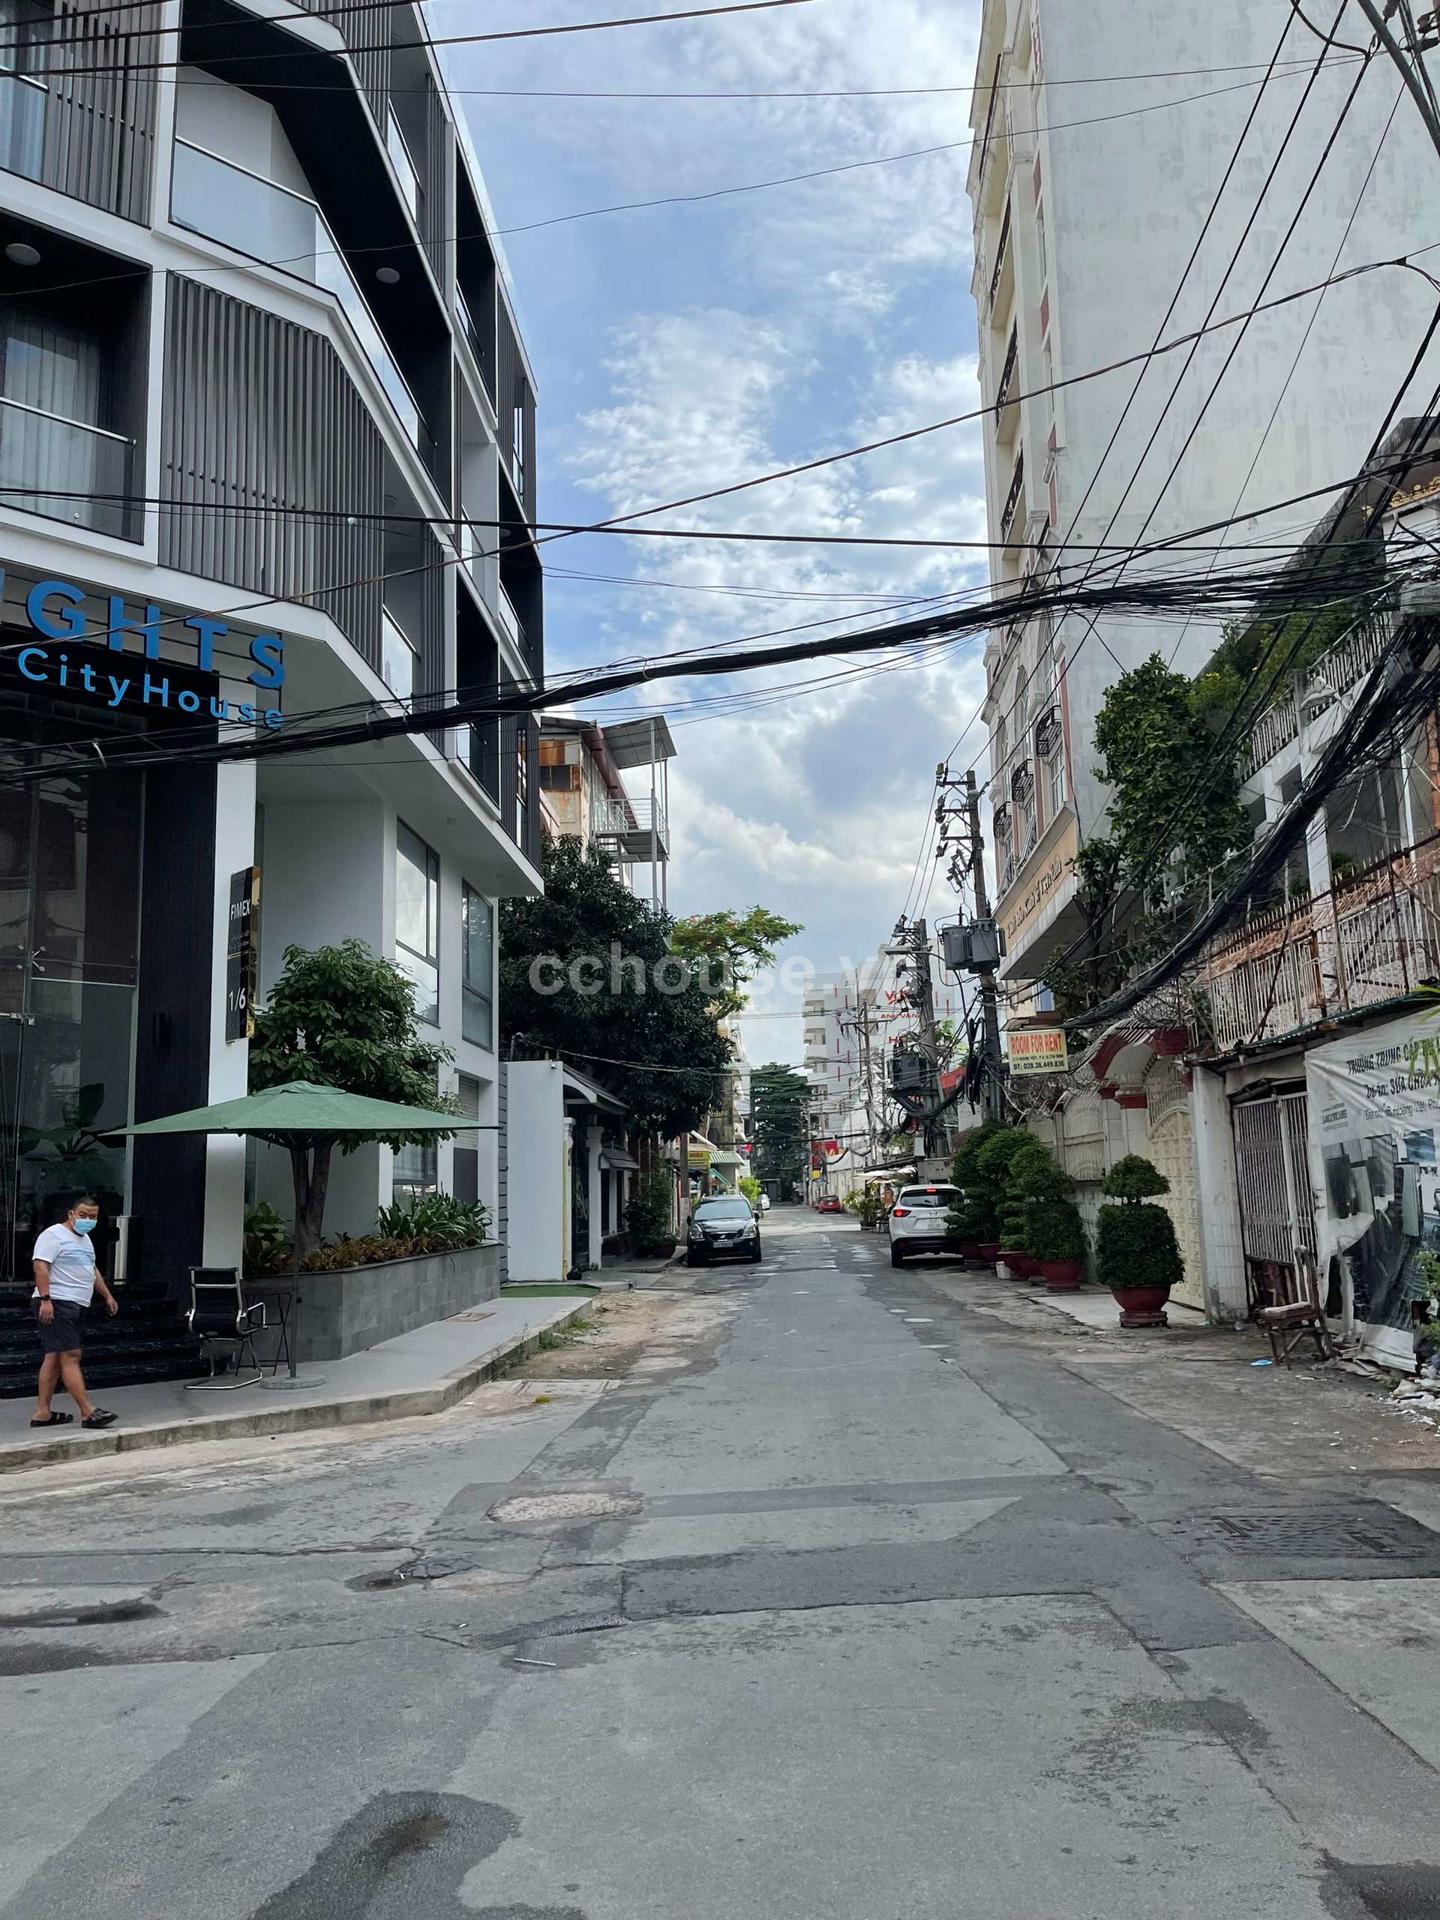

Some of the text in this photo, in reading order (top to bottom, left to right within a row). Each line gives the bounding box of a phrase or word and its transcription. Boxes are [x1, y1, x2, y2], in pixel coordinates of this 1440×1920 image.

[17, 647, 285, 731] CityHouse
[230, 899, 252, 921] FIMEX
[228, 988, 246, 1011] 1/6
[1011, 1033, 1061, 1055] ROOM FOR RENT
[1376, 1046, 1401, 1069] TRUNG
